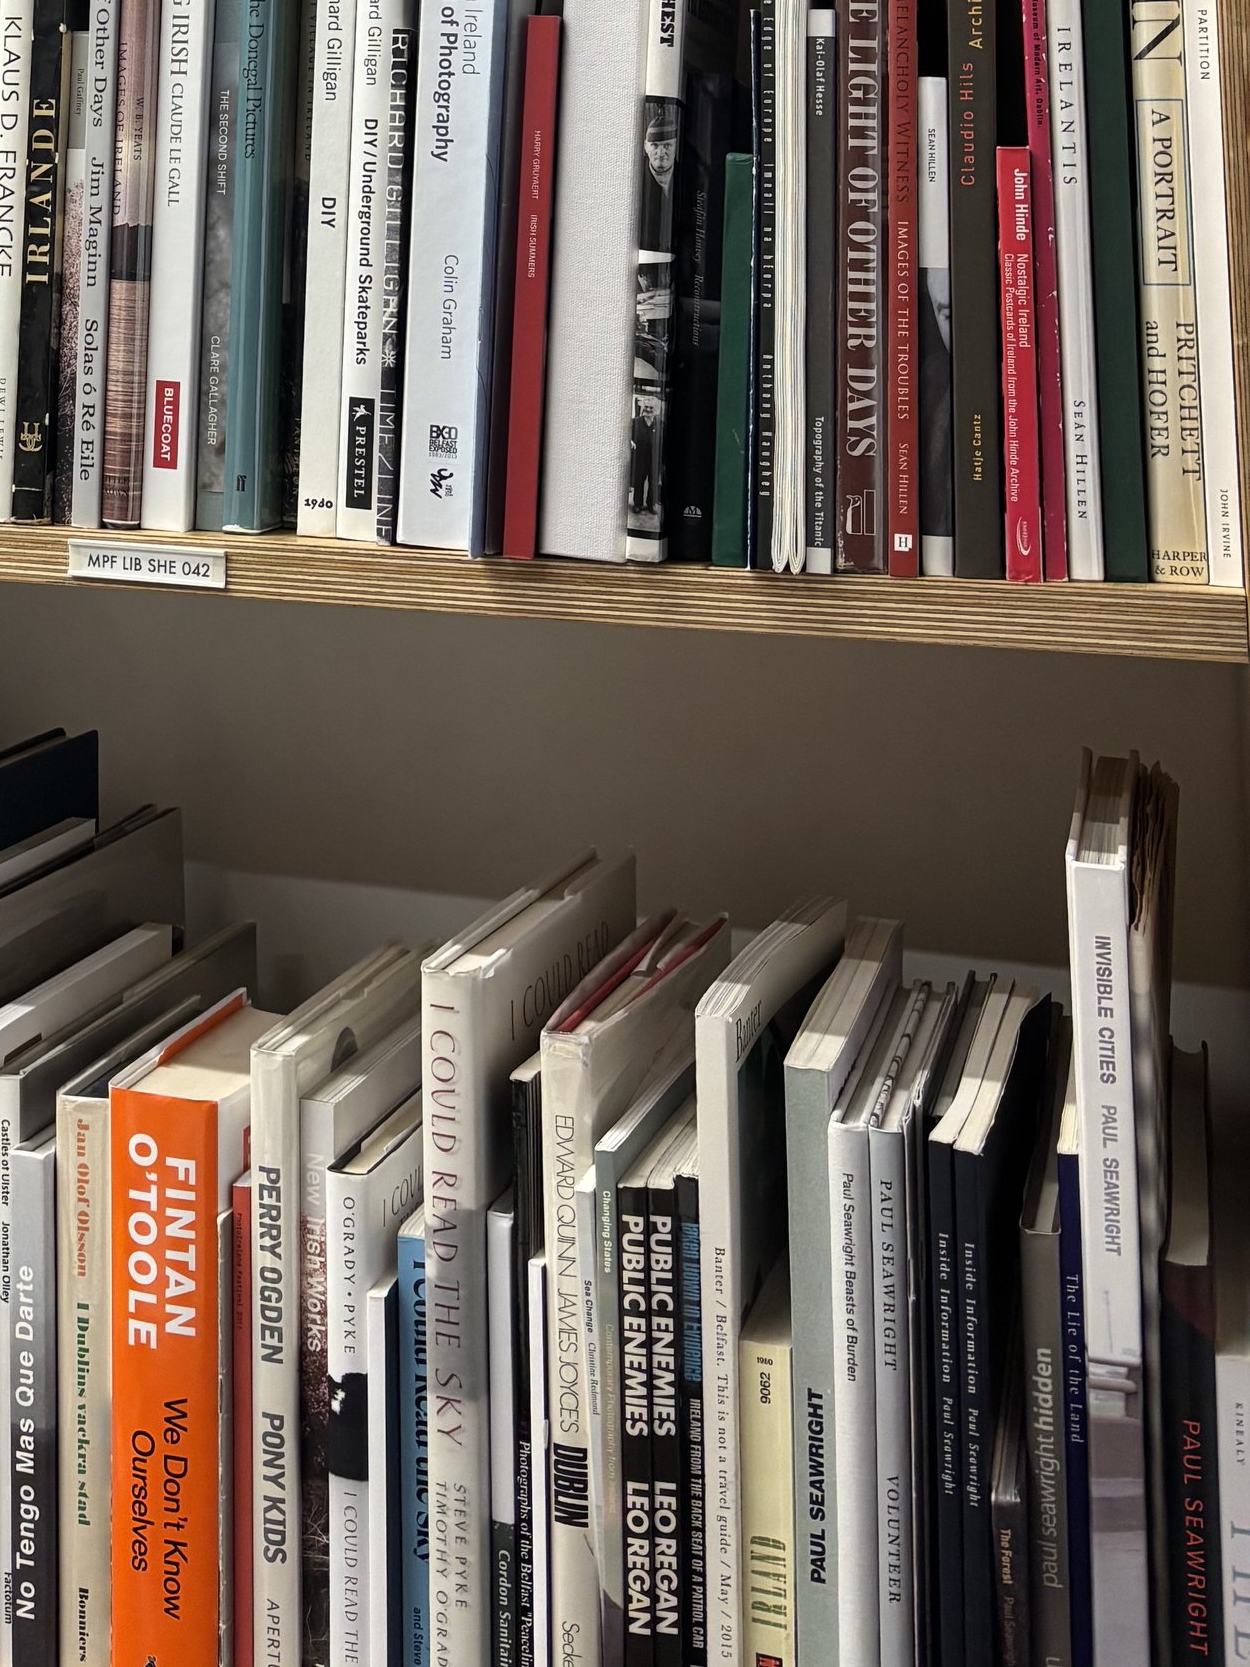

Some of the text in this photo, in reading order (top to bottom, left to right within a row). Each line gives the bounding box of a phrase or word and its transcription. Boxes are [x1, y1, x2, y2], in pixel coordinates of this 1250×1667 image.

[168, 13, 192, 77] IRISH
[438, 4, 460, 26] of
[460, 8, 484, 75] Ireland
[323, 35, 343, 102] Gilligan
[431, 32, 458, 163] Photography
[168, 83, 185, 143] CLAUDE
[1057, 26, 1077, 186] IRELANTIS
[1153, 110, 1174, 129] A
[166, 169, 183, 207] GALL
[168, 148, 184, 165] LE
[319, 196, 338, 228] DIY
[1154, 136, 1180, 272] PORTRAIT
[440, 254, 460, 292] Colin
[438, 297, 458, 360] Graham
[159, 387, 174, 461] BLUECOAT
[88, 554, 210, 578] MPF LIB SHE 042
[1094, 934, 1122, 1257] INVISIBLE CITIES PAUL SEAWRIGHT
[127, 1132, 158, 1350] O'TOOLE
[164, 1156, 197, 1338] FINTAN
[257, 1165, 287, 1565] PERRY OGDEN PONY KIDS
[129, 1429, 154, 1572] Ourselves
[161, 1398, 189, 1621] We Don't Know
